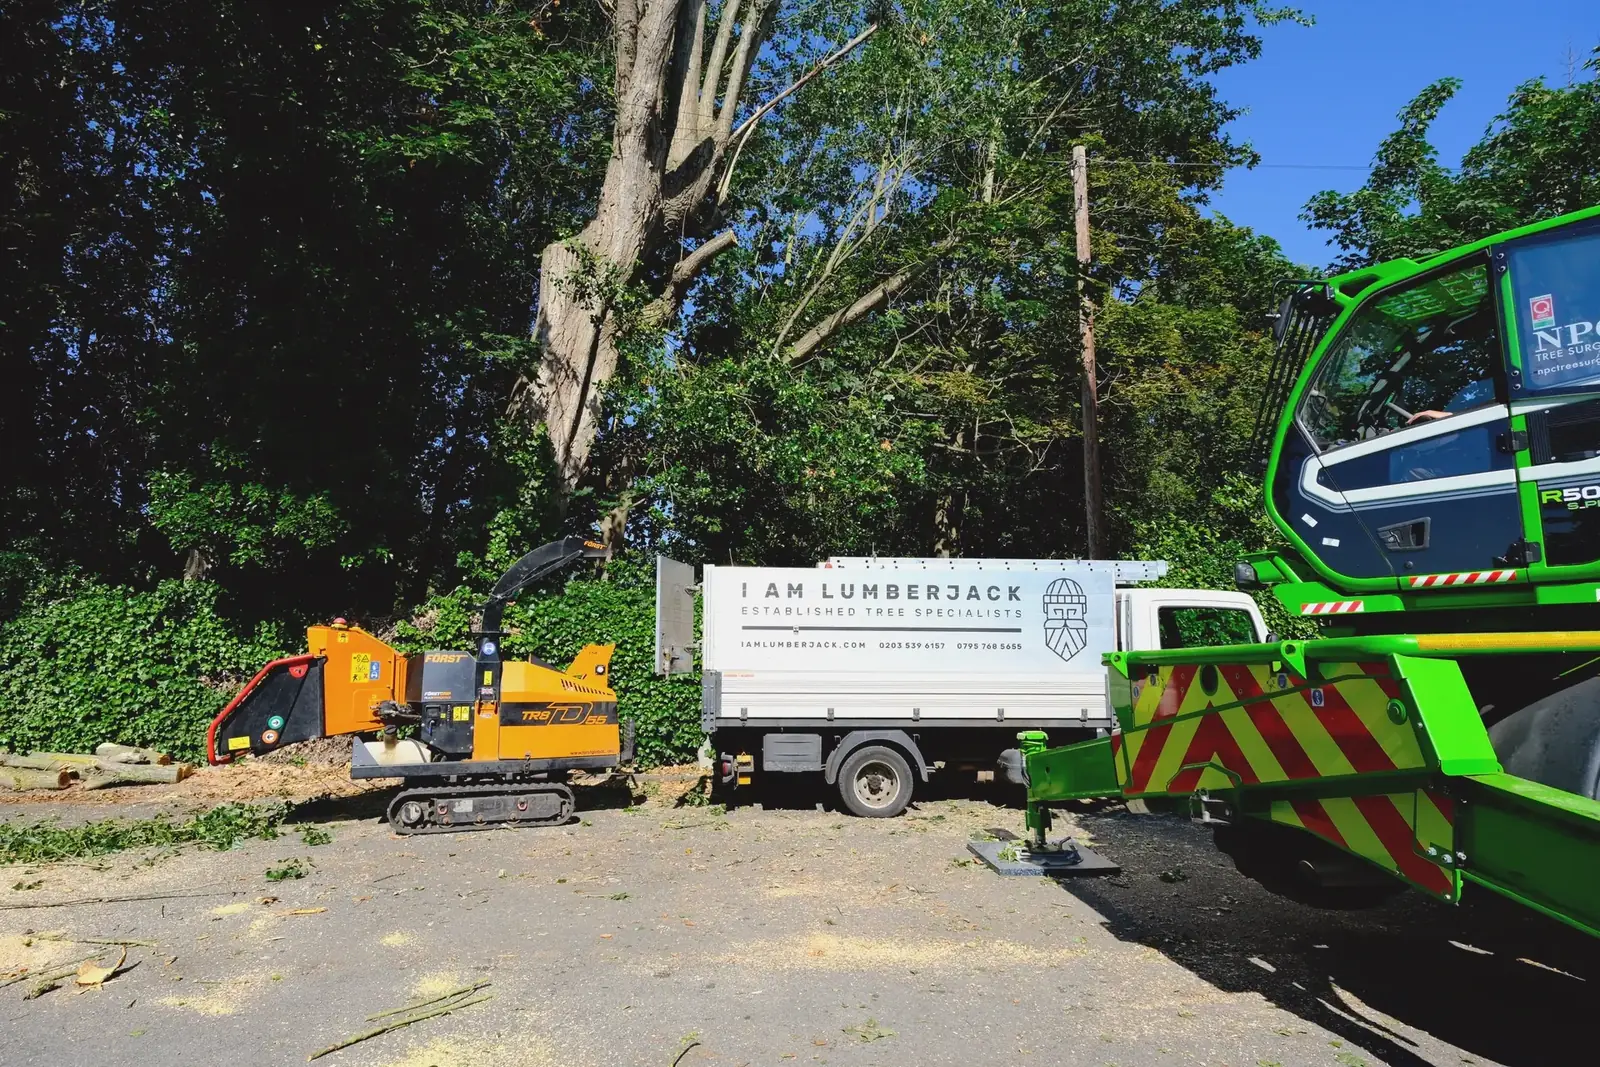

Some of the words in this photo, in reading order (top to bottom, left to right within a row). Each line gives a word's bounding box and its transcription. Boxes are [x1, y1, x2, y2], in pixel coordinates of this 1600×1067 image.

[1535, 349, 1564, 362] TREE
[742, 582, 747, 598] I
[765, 582, 803, 599] AM
[822, 583, 1022, 602] LUMBERJACK
[741, 607, 856, 617] ESTABLISHED
[865, 607, 905, 617] TREE
[914, 608, 1022, 619] SPECIALISTS
[741, 641, 866, 649] IAMLUMBERJACK.COM
[905, 642, 922, 650] 539
[924, 642, 946, 650] 6157
[956, 642, 979, 650] 0795
[981, 642, 998, 650] 768
[999, 642, 1022, 651] 5655
